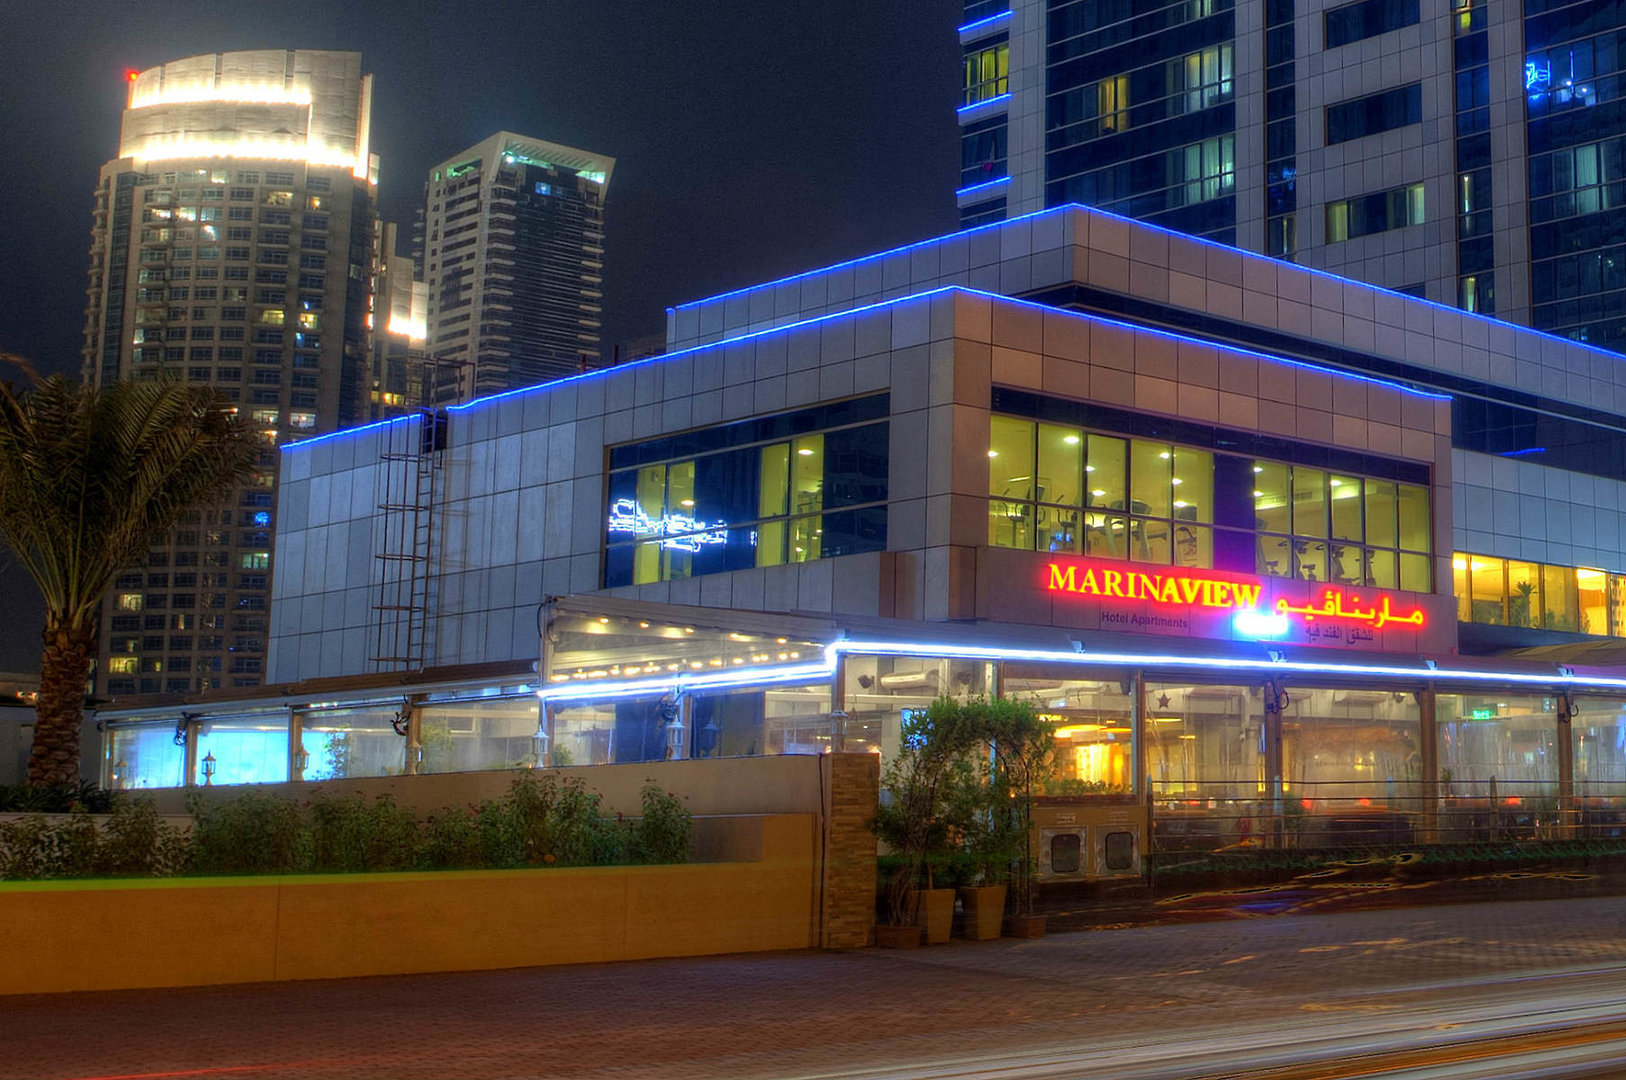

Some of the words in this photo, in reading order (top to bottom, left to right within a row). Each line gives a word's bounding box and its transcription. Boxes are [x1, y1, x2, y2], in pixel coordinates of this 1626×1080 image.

[1047, 563, 1262, 609] MARINAVIEW
[1102, 611, 1128, 623] Hotel
[1130, 613, 1189, 629] Apartments
